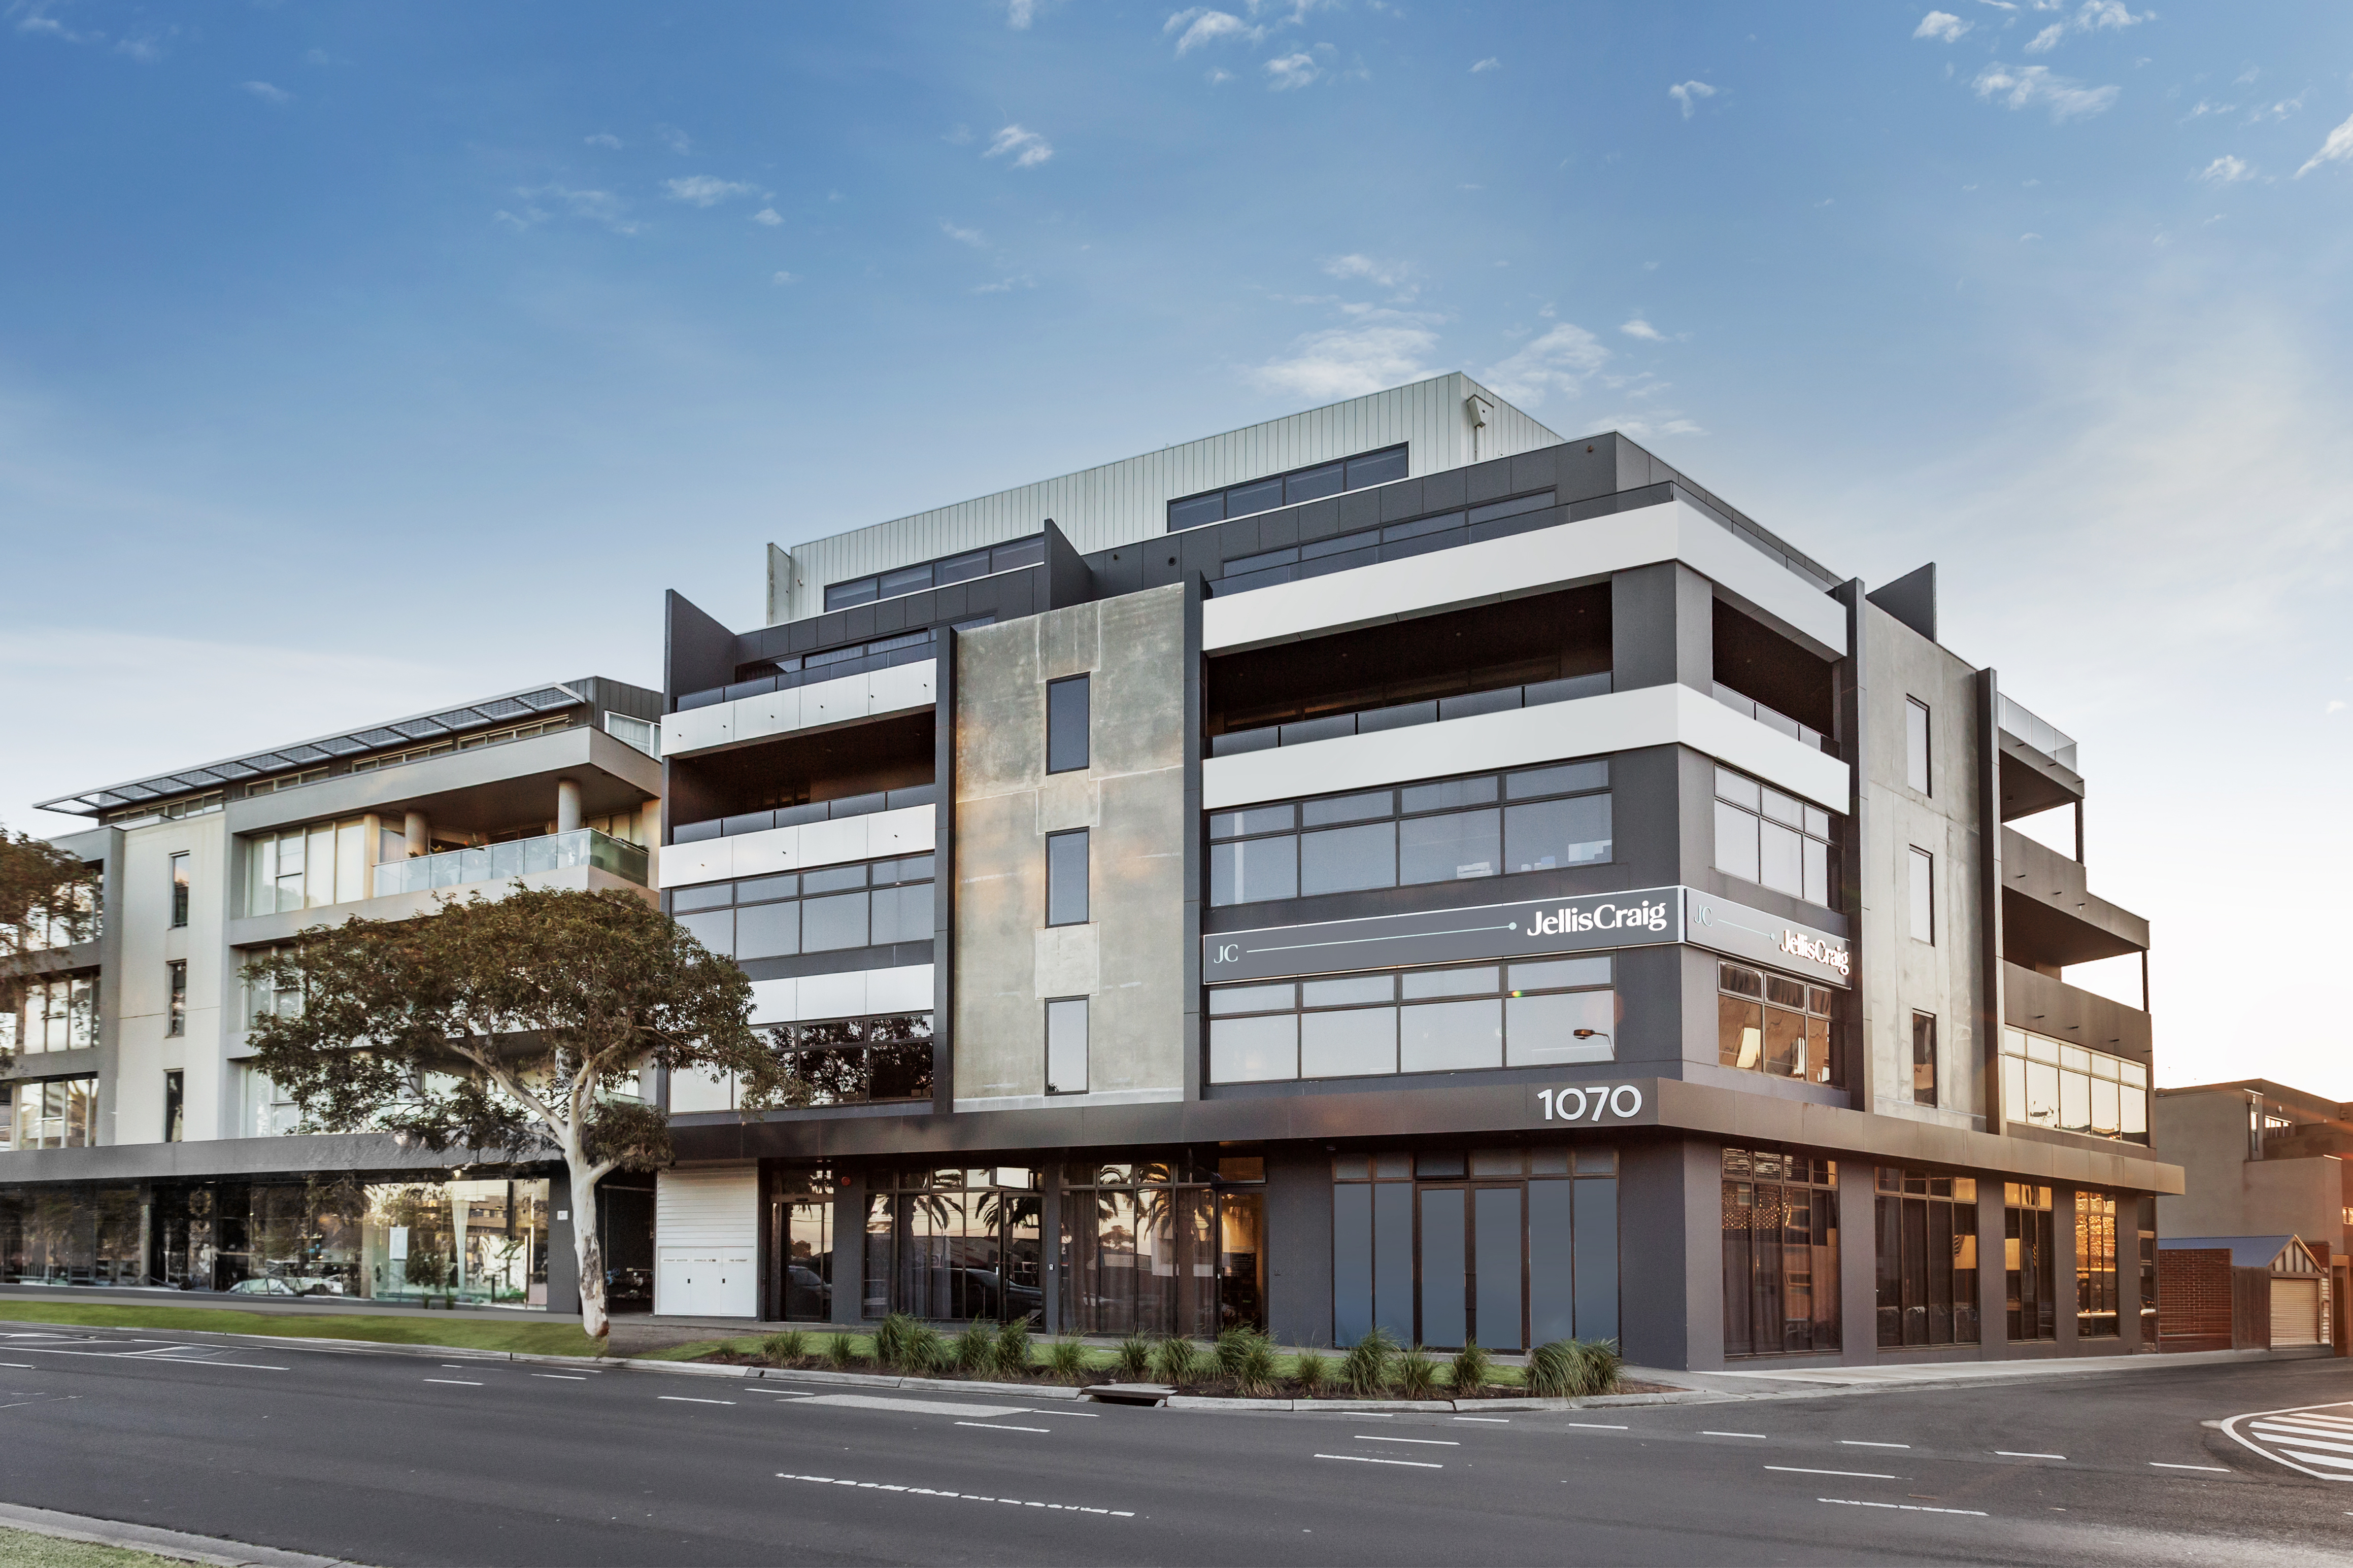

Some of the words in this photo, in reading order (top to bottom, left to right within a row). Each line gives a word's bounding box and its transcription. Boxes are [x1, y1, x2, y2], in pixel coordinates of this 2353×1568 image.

[1694, 904, 1712, 927] JC
[1214, 944, 1238, 964] JC
[1537, 1085, 1642, 1122] 1070
